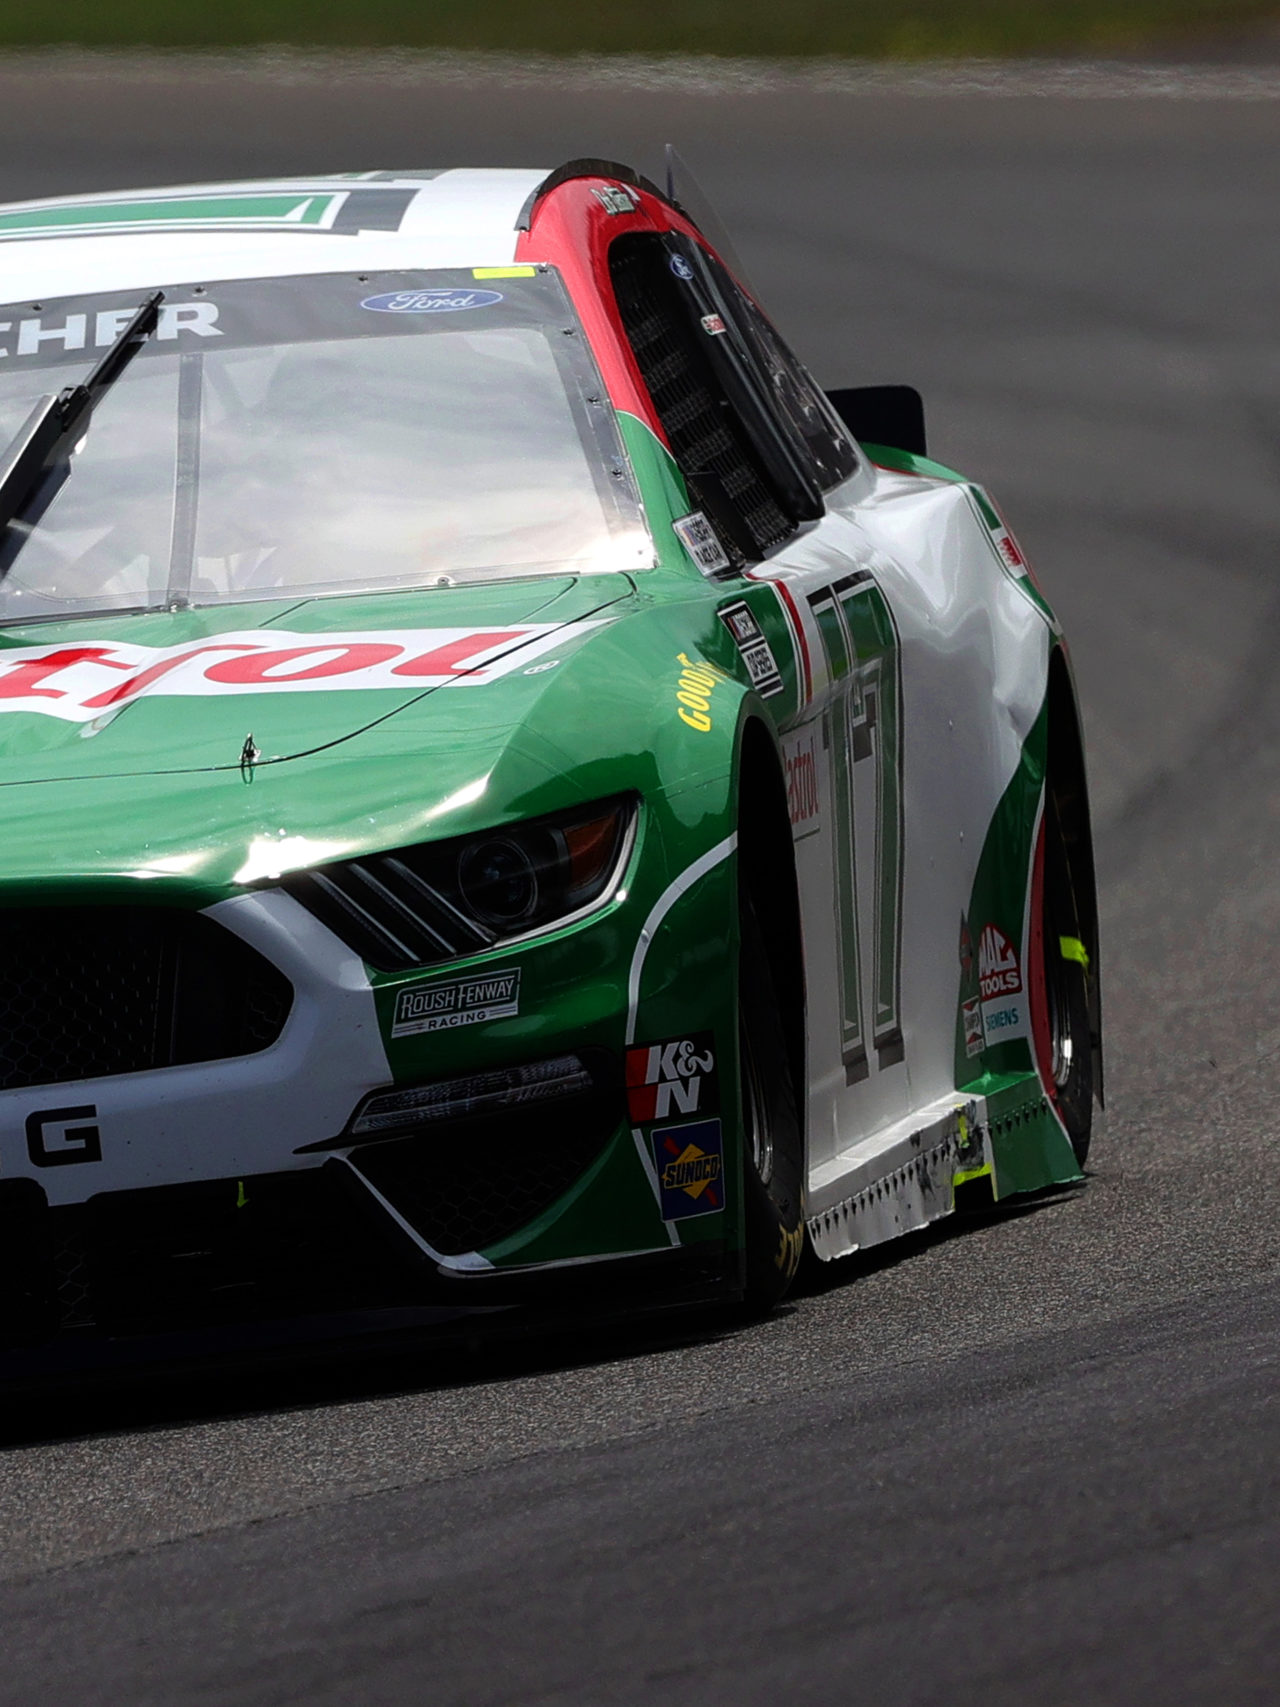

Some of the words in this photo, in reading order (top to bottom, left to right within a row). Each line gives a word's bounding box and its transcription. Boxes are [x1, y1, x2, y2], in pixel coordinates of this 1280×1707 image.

[387, 291, 476, 311] Ford
[979, 971, 1020, 997] TOOLS
[400, 987, 456, 1020] ROUSH
[457, 979, 515, 1009] FENWAY
[427, 1010, 487, 1030] RACING
[665, 1156, 720, 1188] SUNOCO
